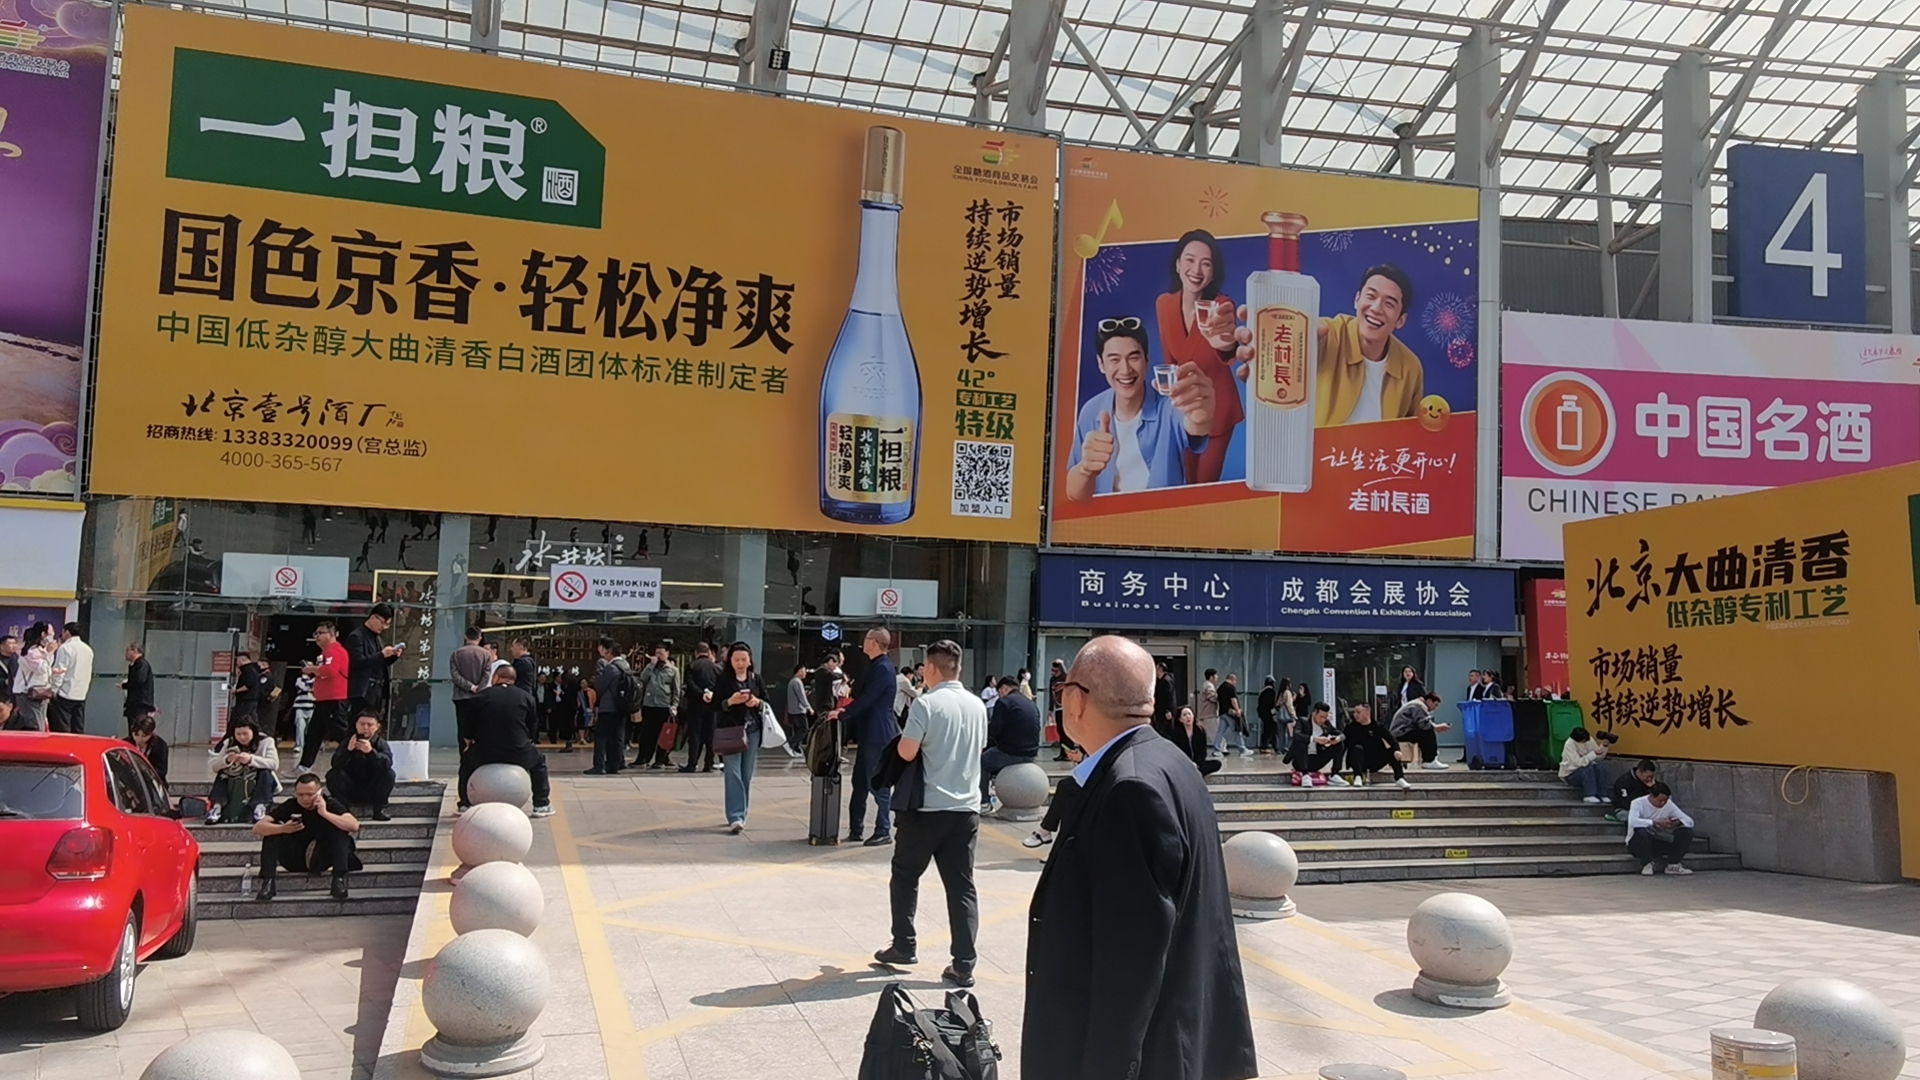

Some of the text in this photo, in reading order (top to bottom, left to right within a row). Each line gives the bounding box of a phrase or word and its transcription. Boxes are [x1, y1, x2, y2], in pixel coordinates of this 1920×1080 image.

[200, 88, 528, 201] 一担粮
[952, 174, 973, 182] CHINA
[953, 164, 1039, 185] 全国糖酒商品交易会
[993, 200, 1024, 301] 市场销量
[1764, 172, 1843, 297] 4
[958, 198, 1012, 364] 持续逆势增长
[157, 310, 789, 395] 中国低杂醇大曲清香白酒团体标准制定者
[958, 391, 1015, 409] 专利工艺
[955, 409, 1015, 440] 特级
[1635, 392, 1872, 463] 中国名酒
[220, 451, 343, 472] 4000-365-567
[838, 425, 853, 491] 轻松净爽
[858, 429, 874, 490] 北京清香
[878, 427, 904, 492] 一担粮
[959, 503, 1004, 515] 加盟入口
[1528, 488, 1658, 515] CHINESE
[592, 578, 658, 588] NO SMOKING
[1079, 568, 1230, 599] 商务中心
[1281, 577, 1471, 606] 成都会展协会
[1586, 530, 1851, 617] 北京大曲清香
[1081, 600, 1231, 611] Business Center
[1280, 607, 1320, 616] Chengdu
[1323, 607, 1371, 616] Convention
[1380, 609, 1421, 617] Exhibition
[1424, 609, 1472, 618] Association
[1666, 585, 1849, 629] 低杂醇专利工艺
[1589, 643, 1683, 690] 市场销量
[1591, 685, 1753, 735] 持续逆势增长
[1621, 788, 1628, 797] 3
